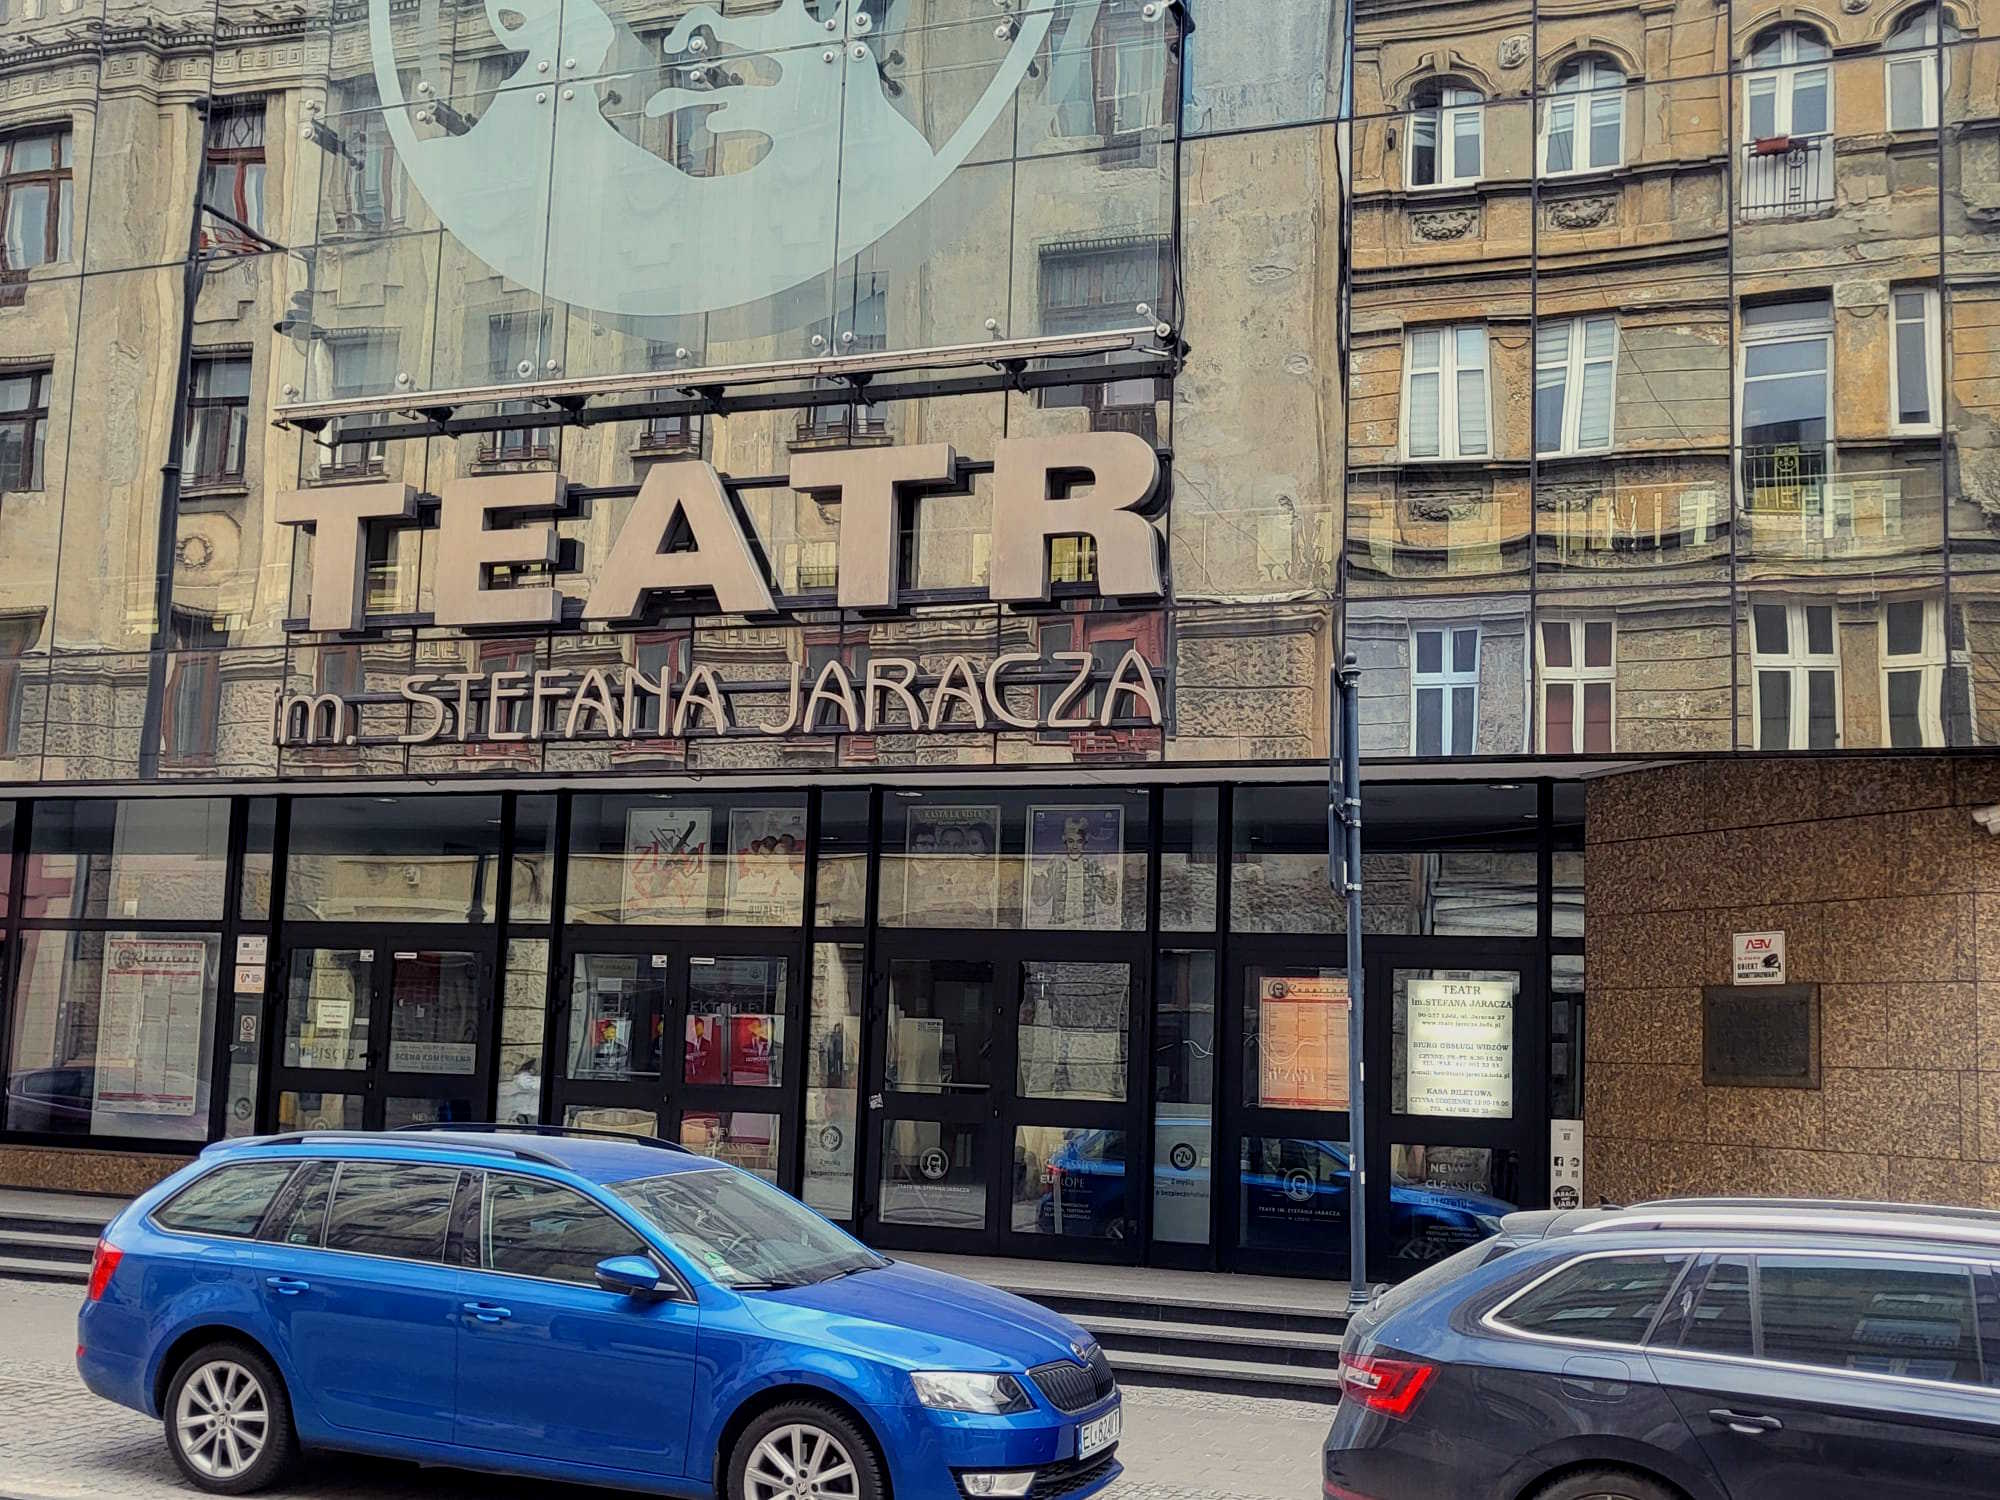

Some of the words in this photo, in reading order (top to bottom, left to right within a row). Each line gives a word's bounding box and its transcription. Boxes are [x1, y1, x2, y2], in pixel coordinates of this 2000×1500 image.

[276, 431, 1163, 632] TEATR
[399, 666, 728, 742] STEFANA
[759, 649, 1162, 734] JARACZA
[1441, 985, 1481, 996] TEATR
[1469, 1000, 1513, 1008] JARACZA
